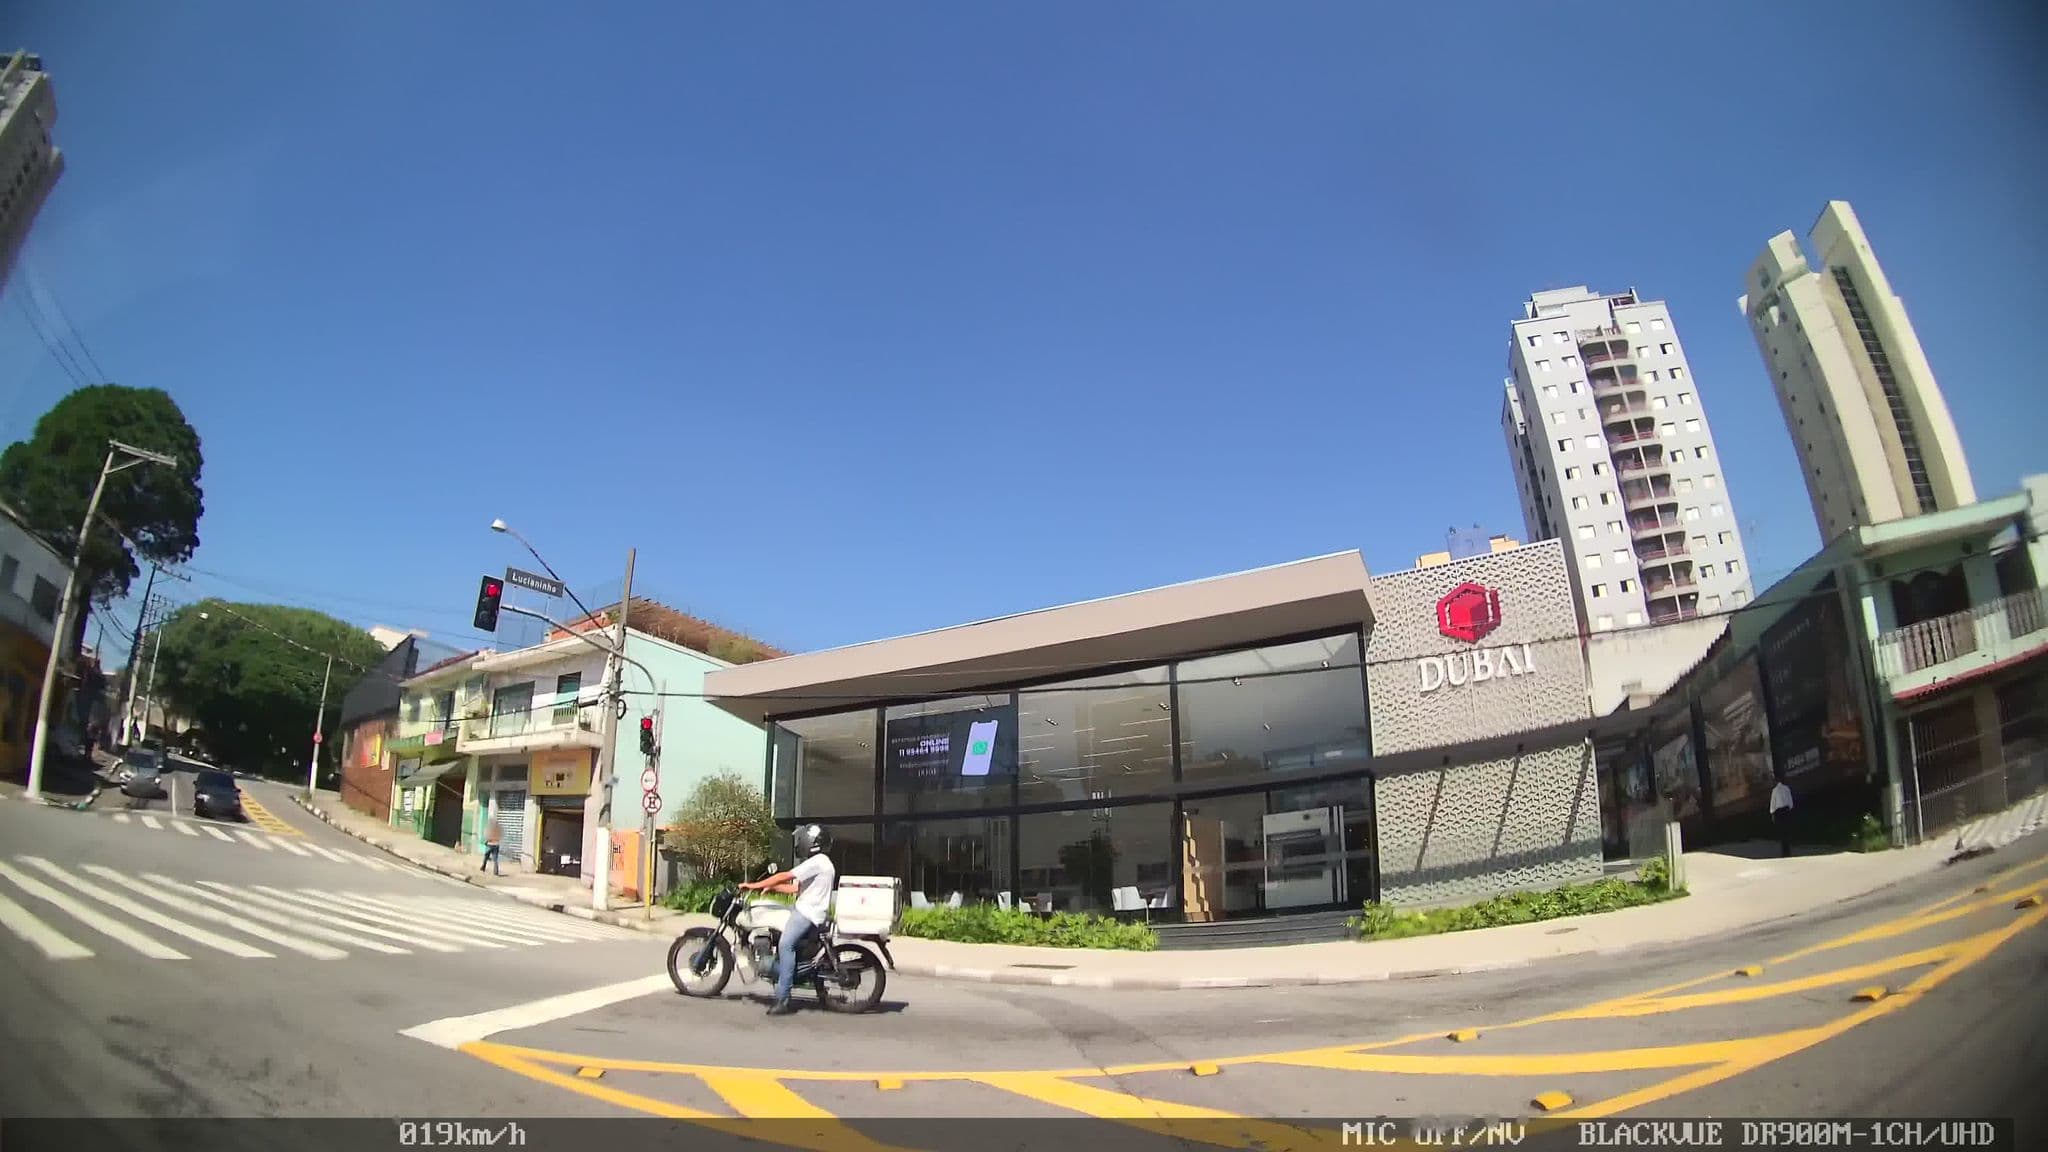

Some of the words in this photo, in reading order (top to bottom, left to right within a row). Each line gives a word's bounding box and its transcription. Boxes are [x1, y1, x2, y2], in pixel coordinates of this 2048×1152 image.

[511, 572, 557, 594] Lucianinho
[1418, 643, 1537, 693] DUBAI
[920, 737, 949, 747] ONLINE
